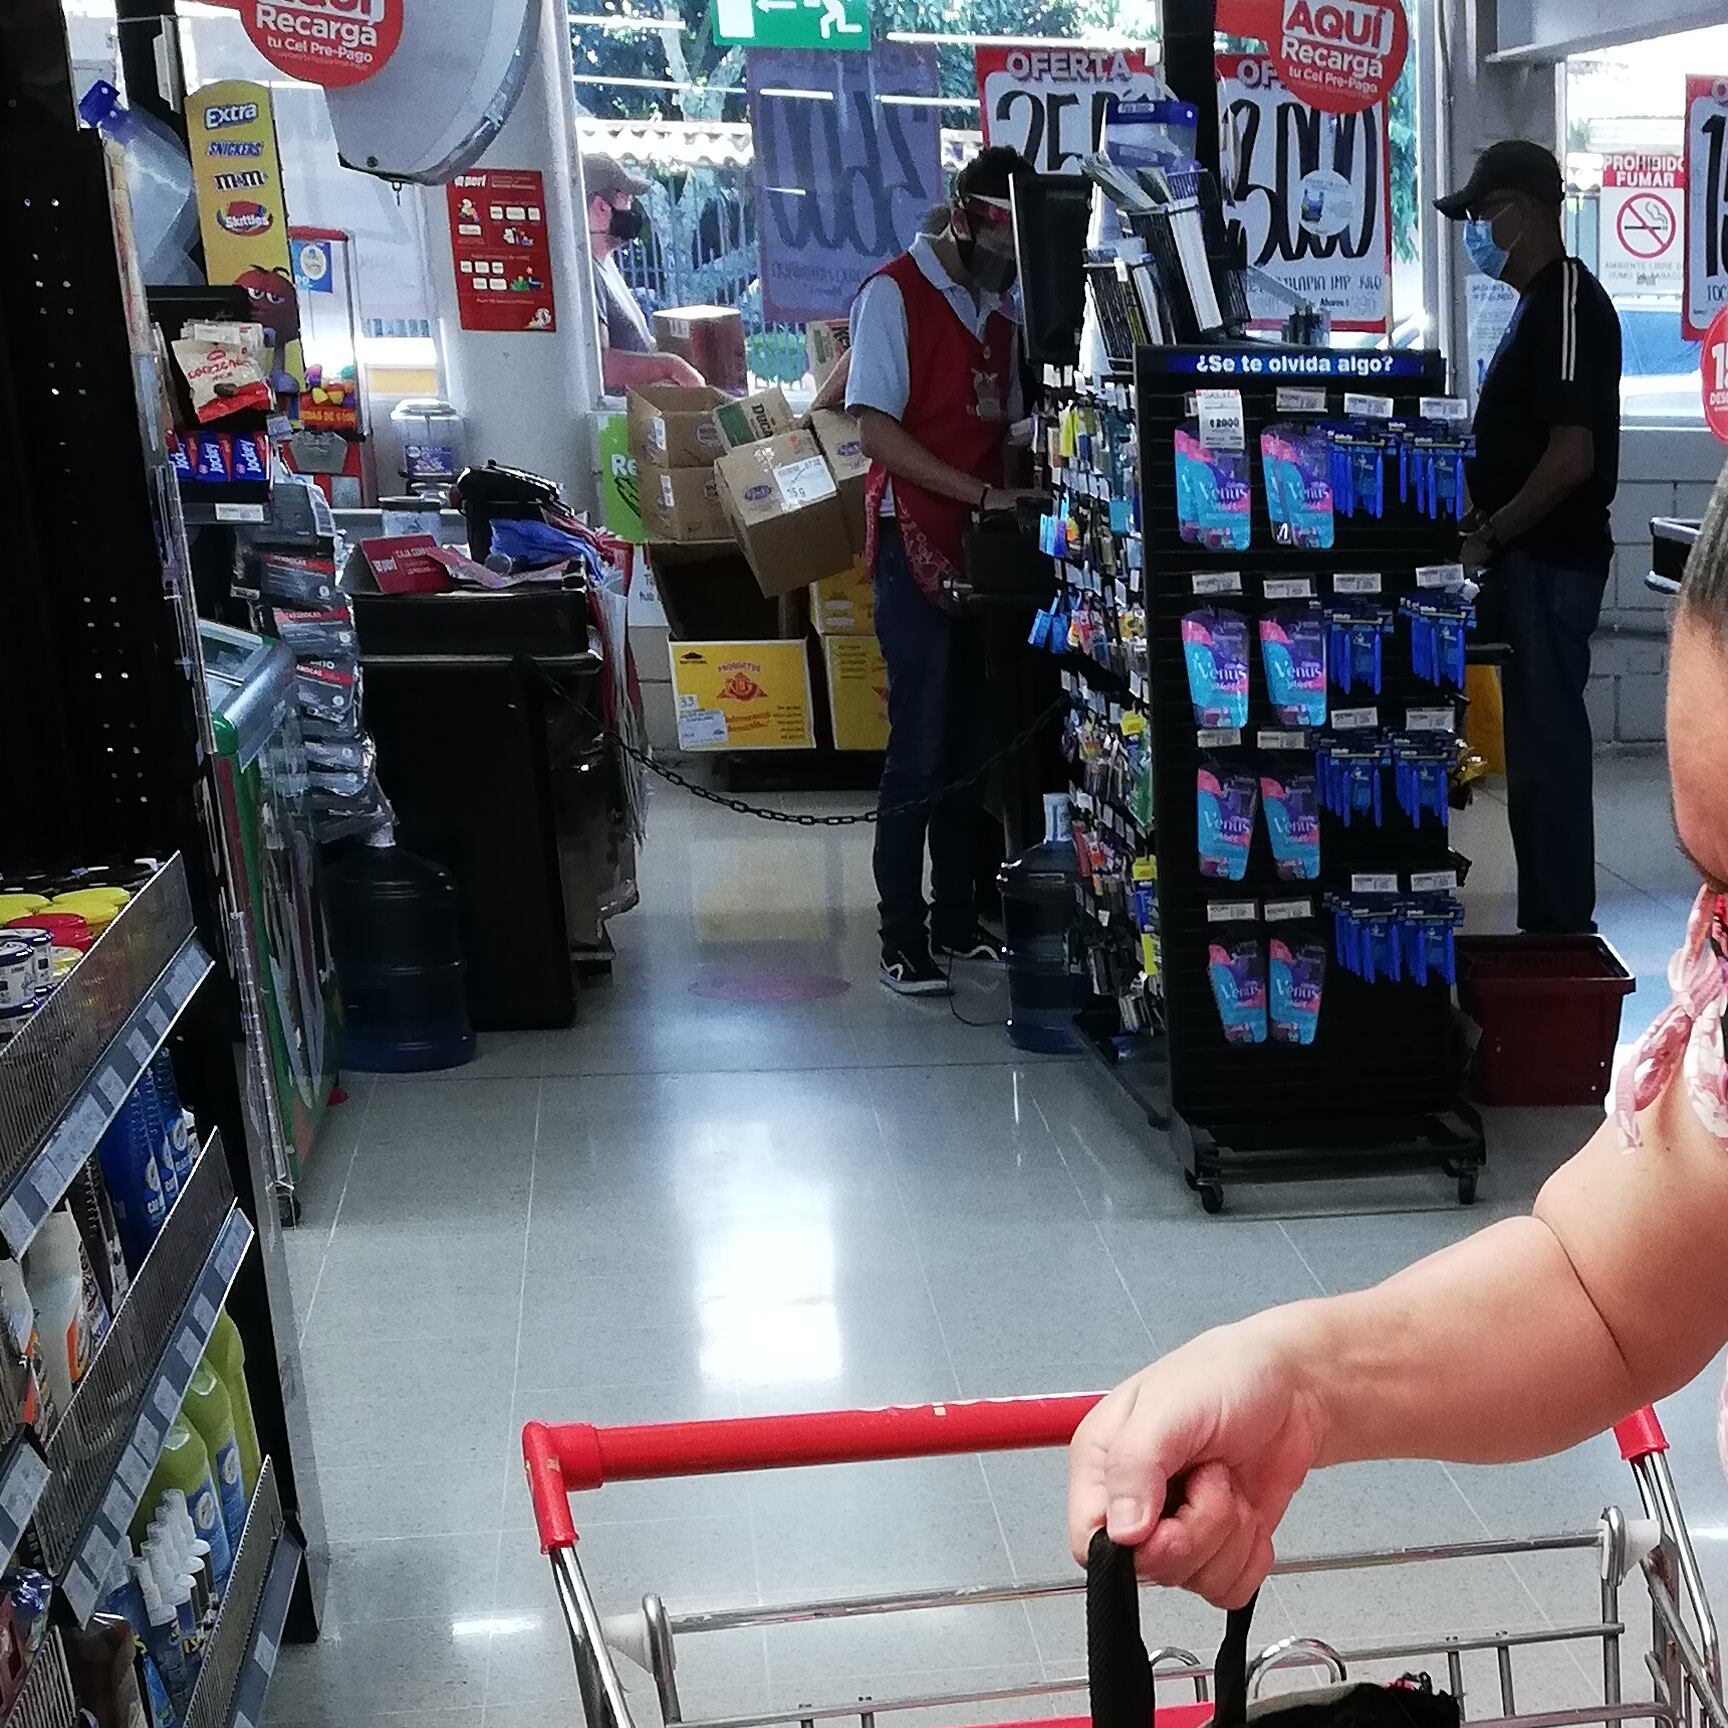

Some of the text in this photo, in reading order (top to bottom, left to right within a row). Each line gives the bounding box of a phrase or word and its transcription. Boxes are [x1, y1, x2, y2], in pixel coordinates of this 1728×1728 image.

[256, 4, 377, 48] Recarga
[1285, 2, 1387, 45] AQUÍ
[267, 35, 373, 64] tu Cel Pre-Pago
[1282, 37, 1384, 79] Recarga
[1006, 51, 1132, 81] OFERTA
[1288, 66, 1302, 80] tu
[1303, 69, 1324, 83] Cel
[1324, 70, 1378, 94] Pre-Pago
[205, 103, 257, 128] Extra
[207, 140, 263, 157] SNICKERS
[1616, 171, 1675, 188] FUMAR
[1196, 355, 1393, 376] ¿Se te olvida algo?
[1199, 481, 1249, 501] Venus
[1193, 660, 1247, 681] Venus
[1274, 659, 1322, 678] Venus
[1204, 815, 1251, 833] Venus
[1272, 816, 1318, 832] Venus
[1219, 984, 1263, 1002] Venus
[1271, 984, 1321, 1002] Venus
